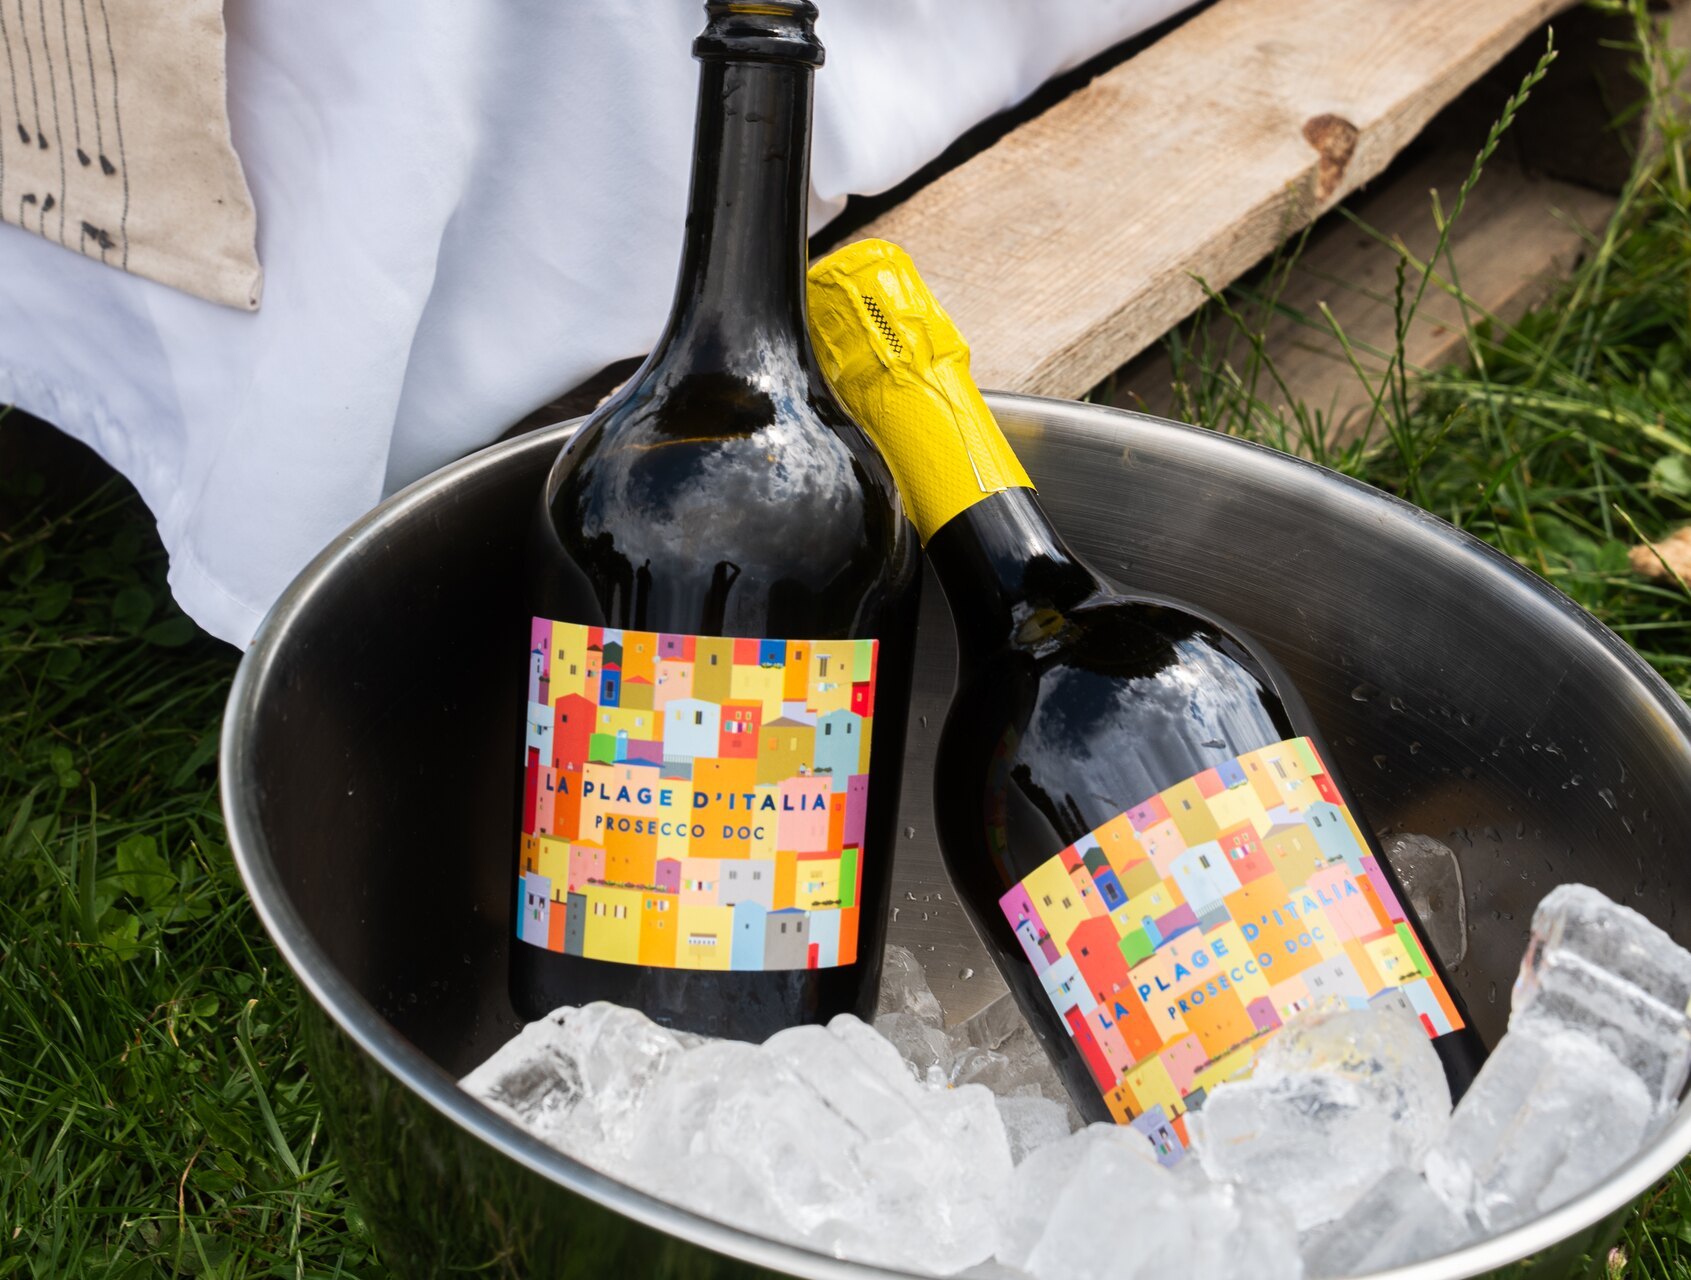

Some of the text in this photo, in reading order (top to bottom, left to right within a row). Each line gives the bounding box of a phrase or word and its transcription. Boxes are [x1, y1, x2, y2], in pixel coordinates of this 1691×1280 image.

[546, 773, 827, 811] LA PLAGE D'ITALIA
[595, 815, 765, 841] PROSECCO DOC
[1099, 877, 1360, 1031] LA PLAGE D'ITALIA
[1168, 926, 1325, 1020] PROSECCO DOC
